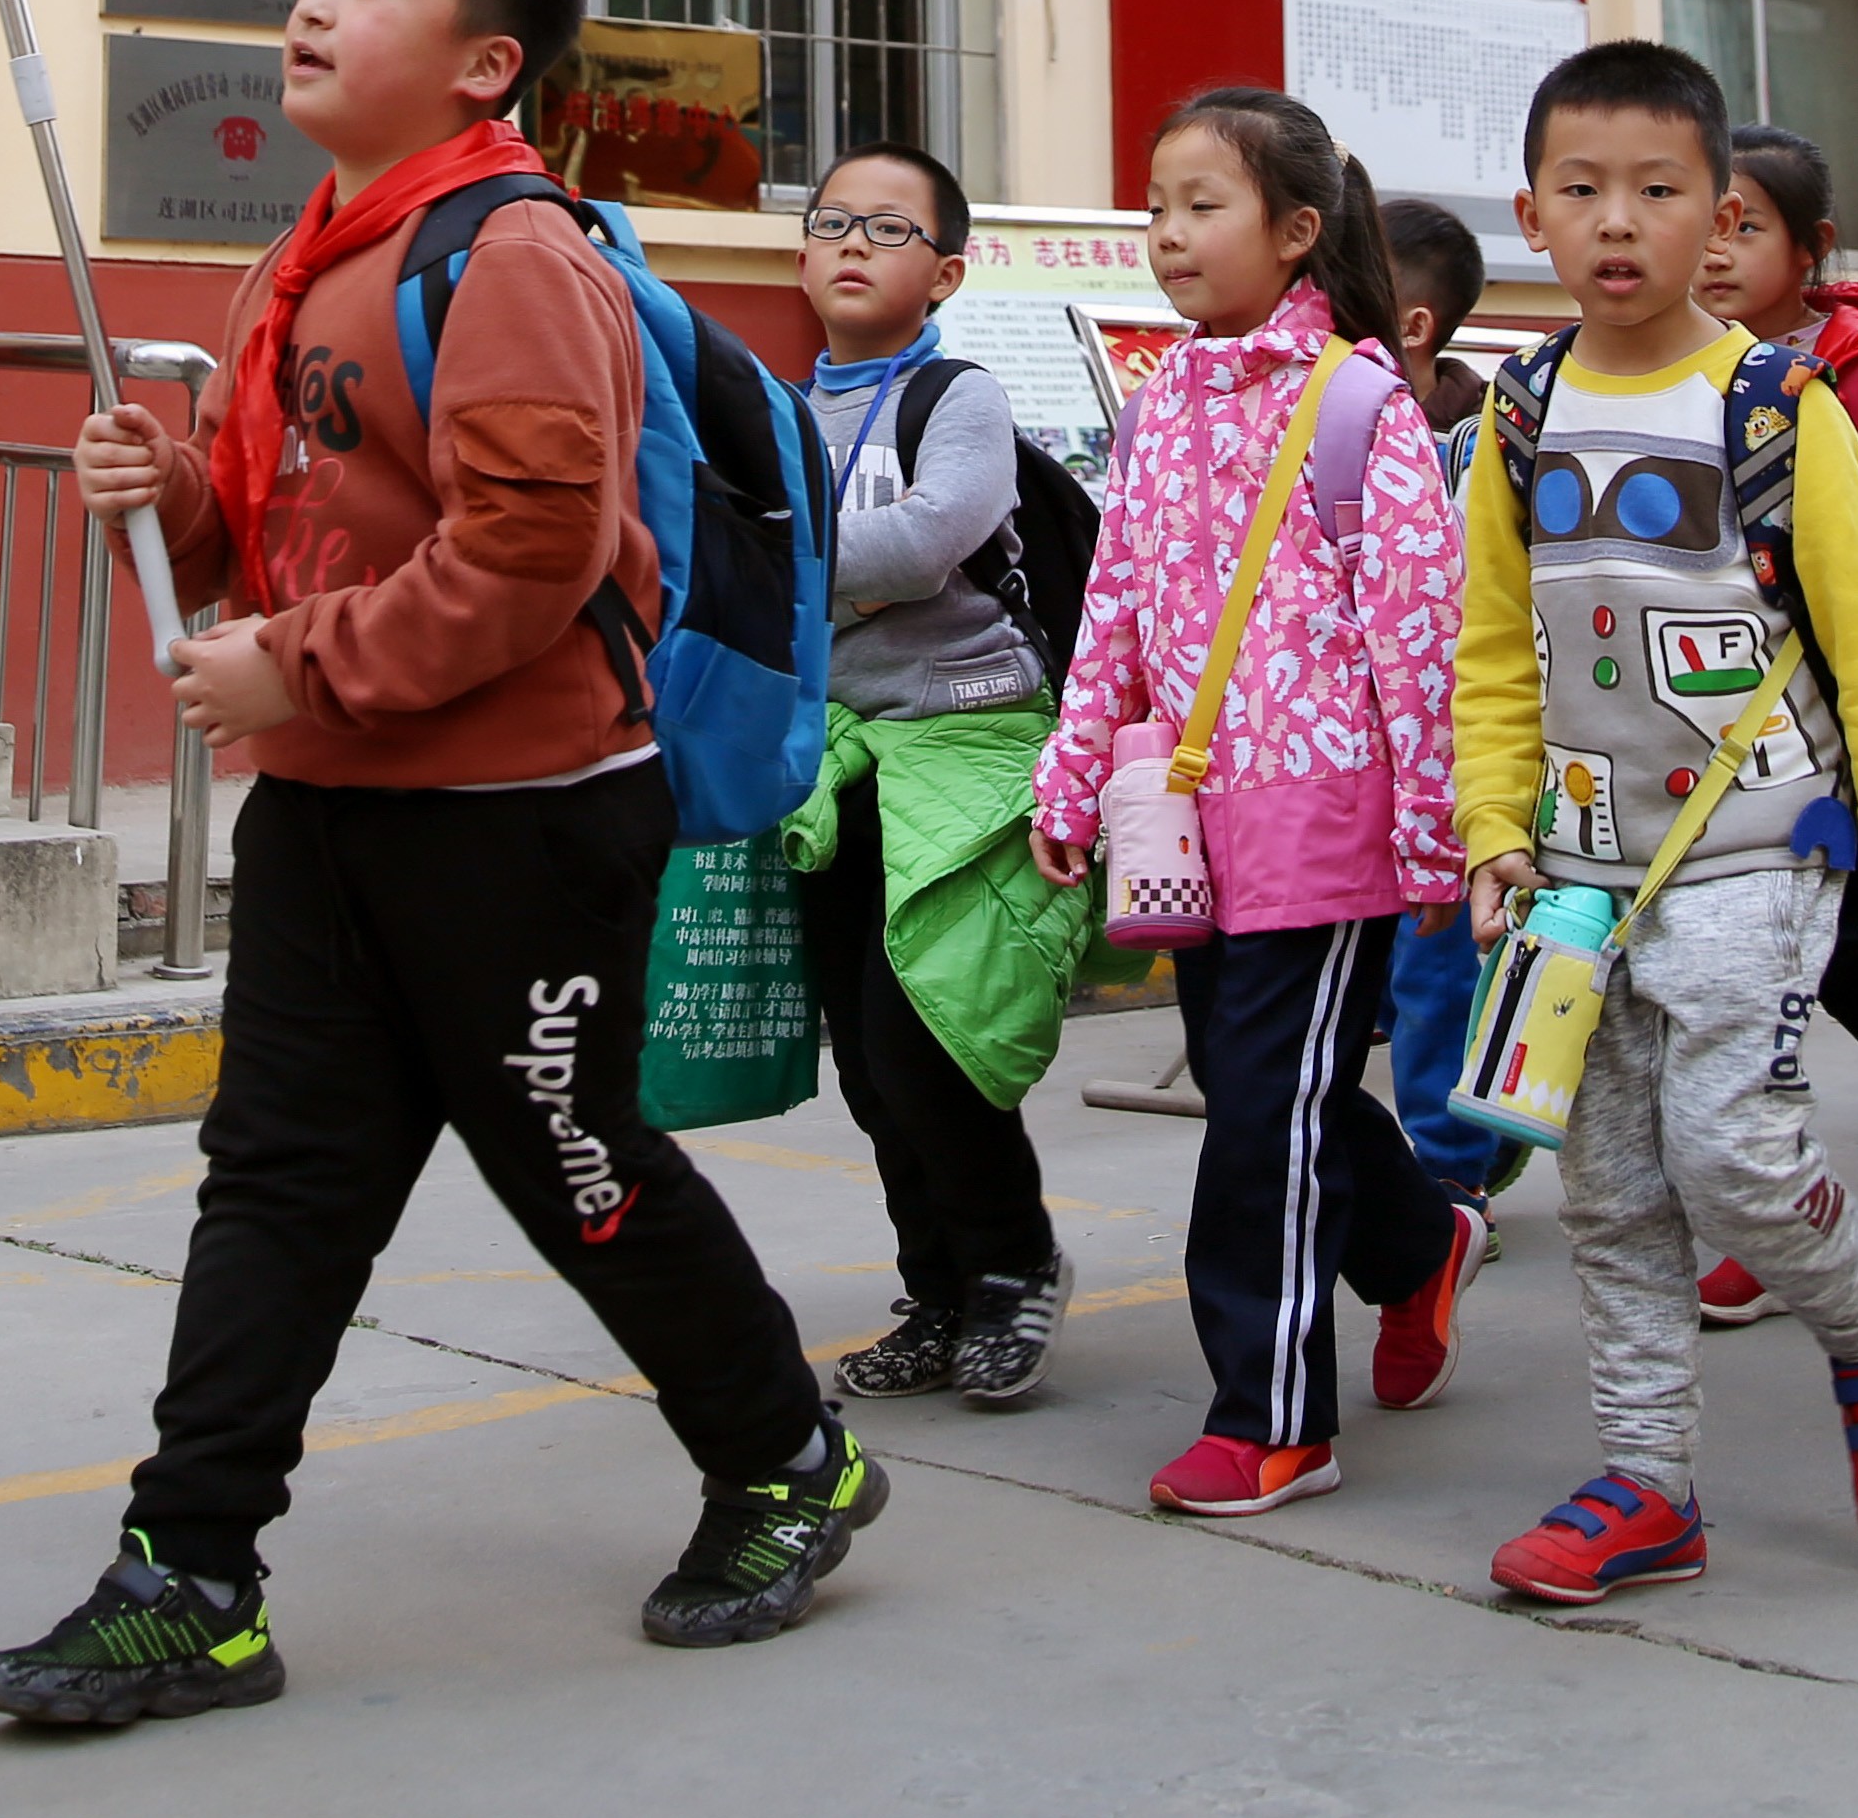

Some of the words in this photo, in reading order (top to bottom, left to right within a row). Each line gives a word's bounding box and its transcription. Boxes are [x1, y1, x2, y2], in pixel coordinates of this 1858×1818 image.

[158, 196, 308, 225] 莲湖区司法局监
[1032, 236, 1142, 269] 志在奉献
[956, 681, 989, 699] TAKE
[692, 851, 717, 871] 书法
[721, 852, 748, 871] 美术
[658, 1000, 699, 1020] 青少儿
[503, 975, 624, 1215] Supreme
